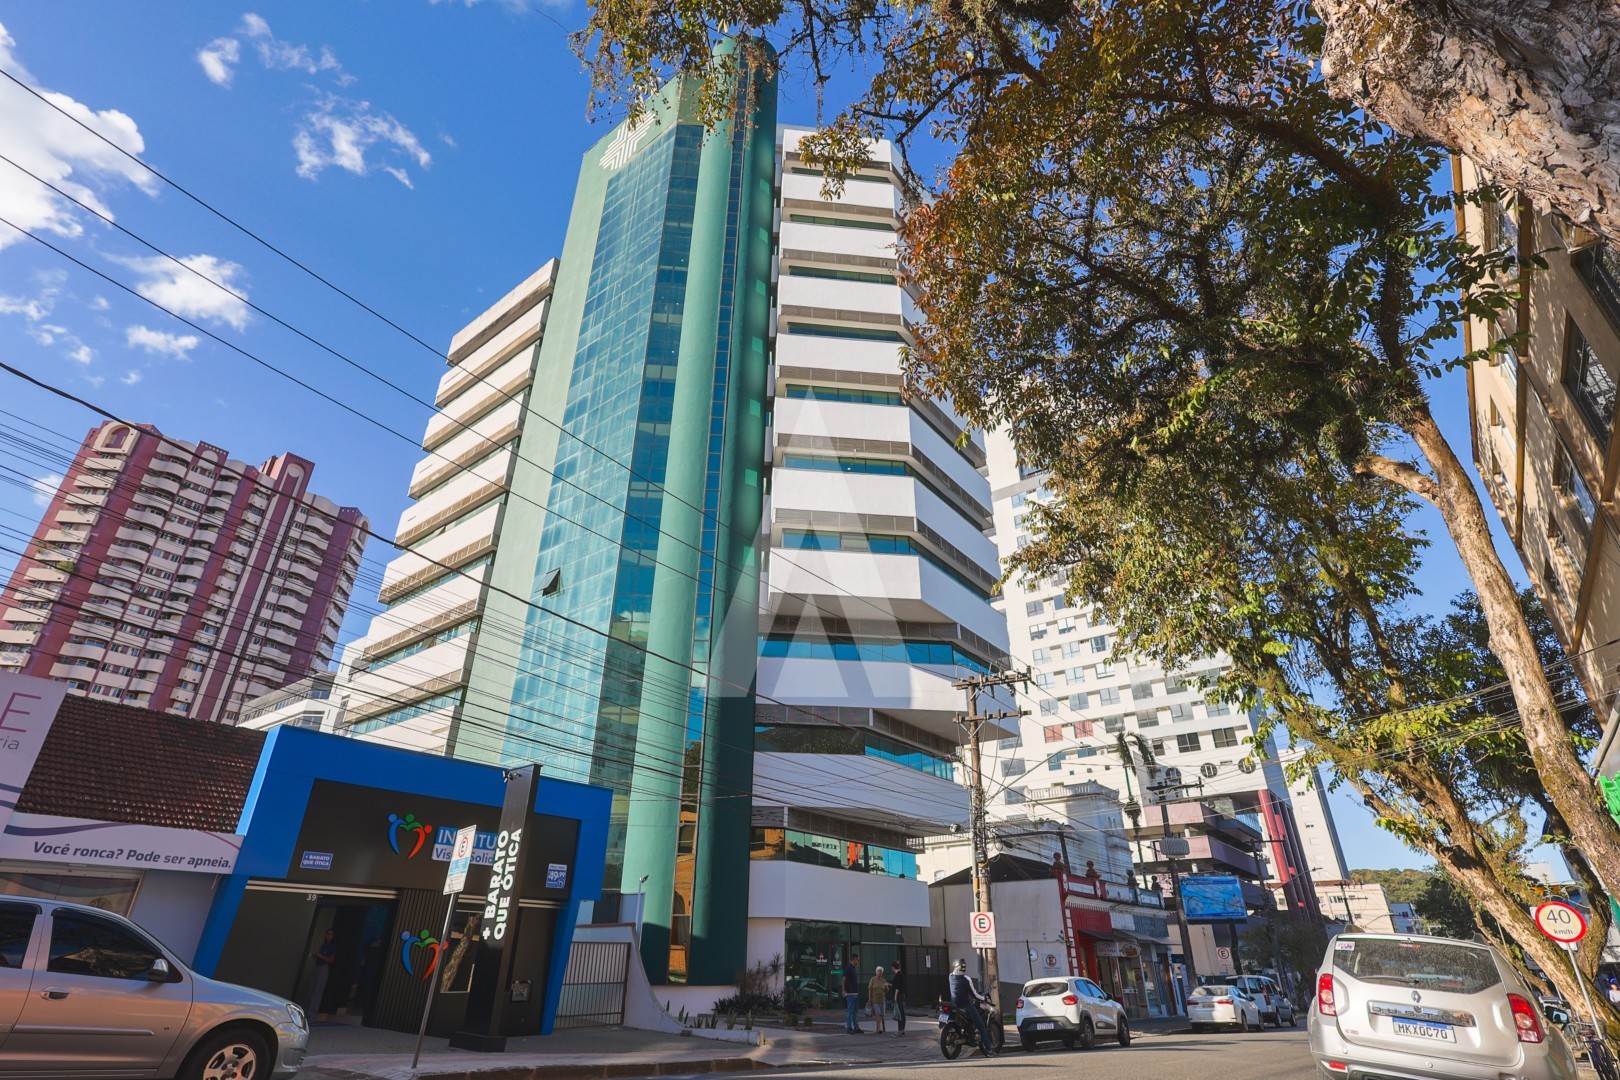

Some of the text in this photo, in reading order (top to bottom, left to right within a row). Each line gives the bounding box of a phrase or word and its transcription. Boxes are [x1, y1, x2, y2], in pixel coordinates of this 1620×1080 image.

[0, 736, 20, 750] ia
[34, 841, 231, 868] Você ronca? Pode ser apneia.
[484, 830, 509, 918] BARATO
[494, 828, 522, 940] QUE ÓTICA
[306, 893, 317, 901] 39
[978, 917, 987, 929] E
[1547, 909, 1571, 924] 40
